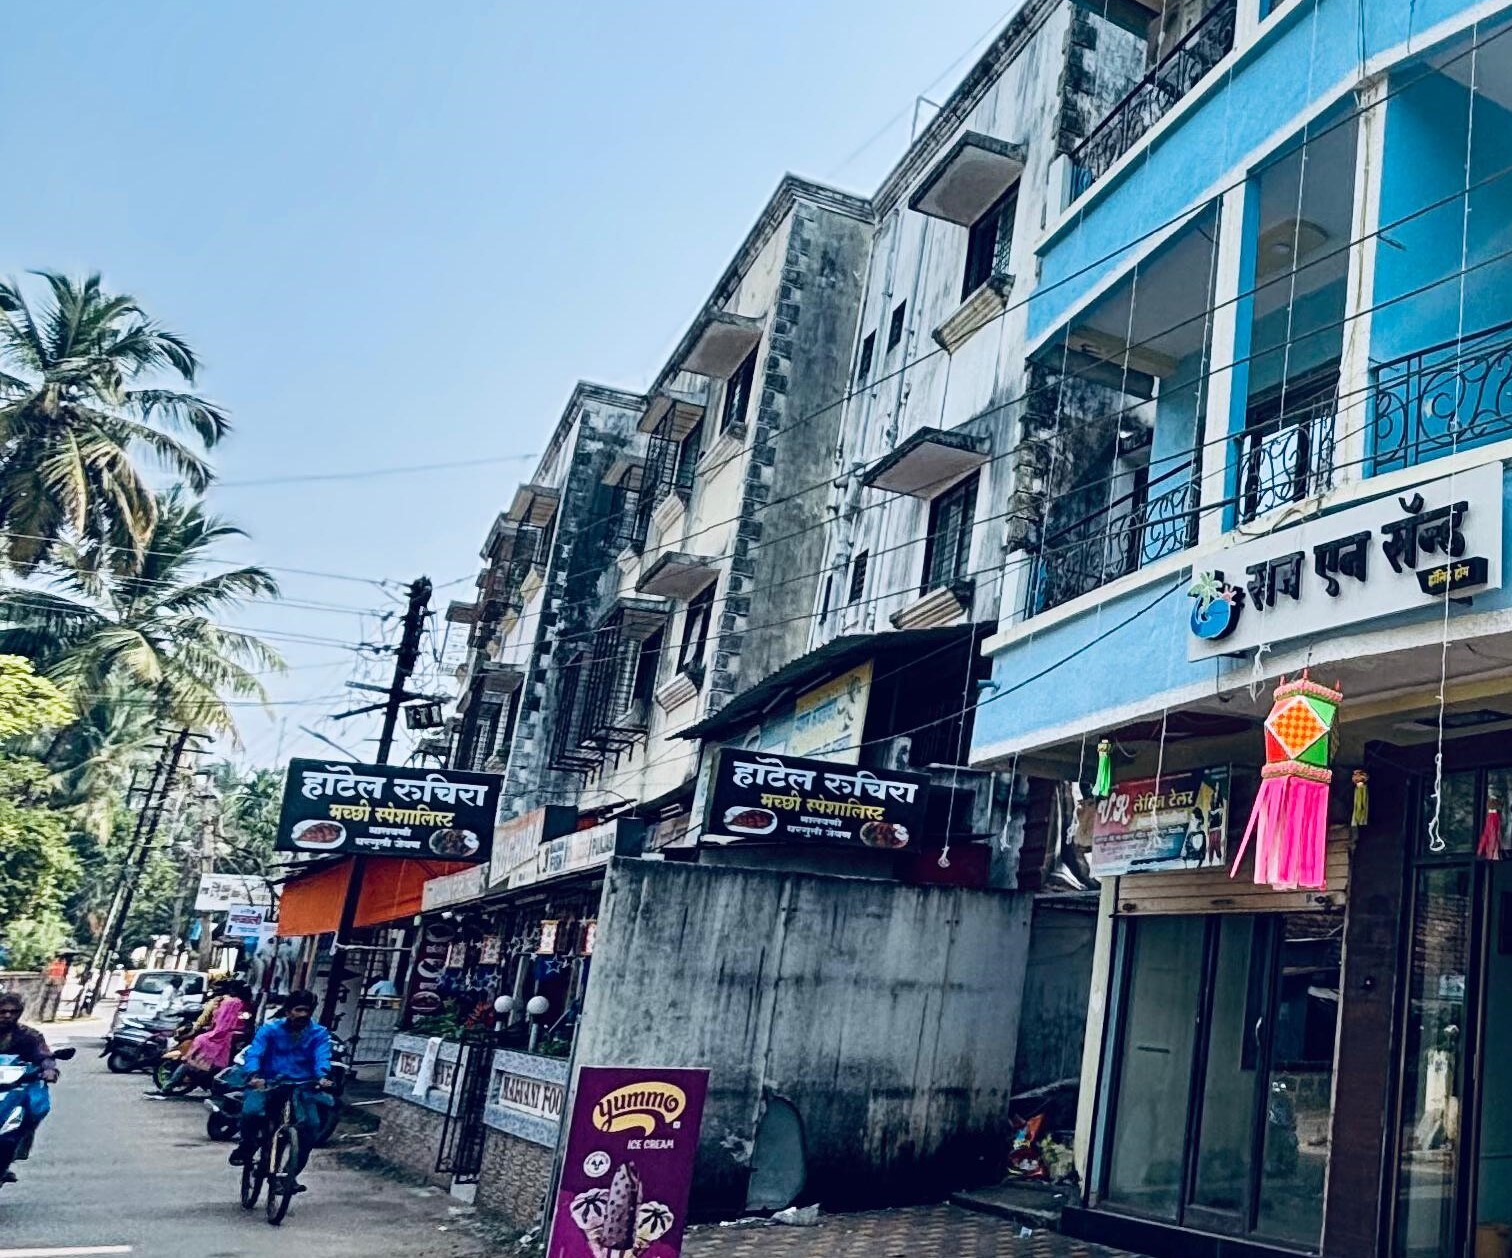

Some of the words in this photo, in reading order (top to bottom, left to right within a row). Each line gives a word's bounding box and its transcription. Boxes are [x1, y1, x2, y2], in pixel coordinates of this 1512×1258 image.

[1246, 550, 1306, 612] सन
[1313, 530, 1372, 598] एन
[301, 764, 387, 800] हॉटेल
[393, 773, 489, 807] रुचिरा
[733, 755, 817, 791] हॉटेल
[824, 770, 919, 804] रुचिरा
[329, 799, 372, 822] मच्छी
[375, 801, 456, 828] स्पेशालिस्ट
[760, 790, 803, 812] मच्छी
[806, 794, 886, 821] स्पेशालिस्ट
[1168, 788, 1194, 808] टेलर
[627, 1139, 642, 1150] ICE
[643, 1139, 675, 1150] CREAM
